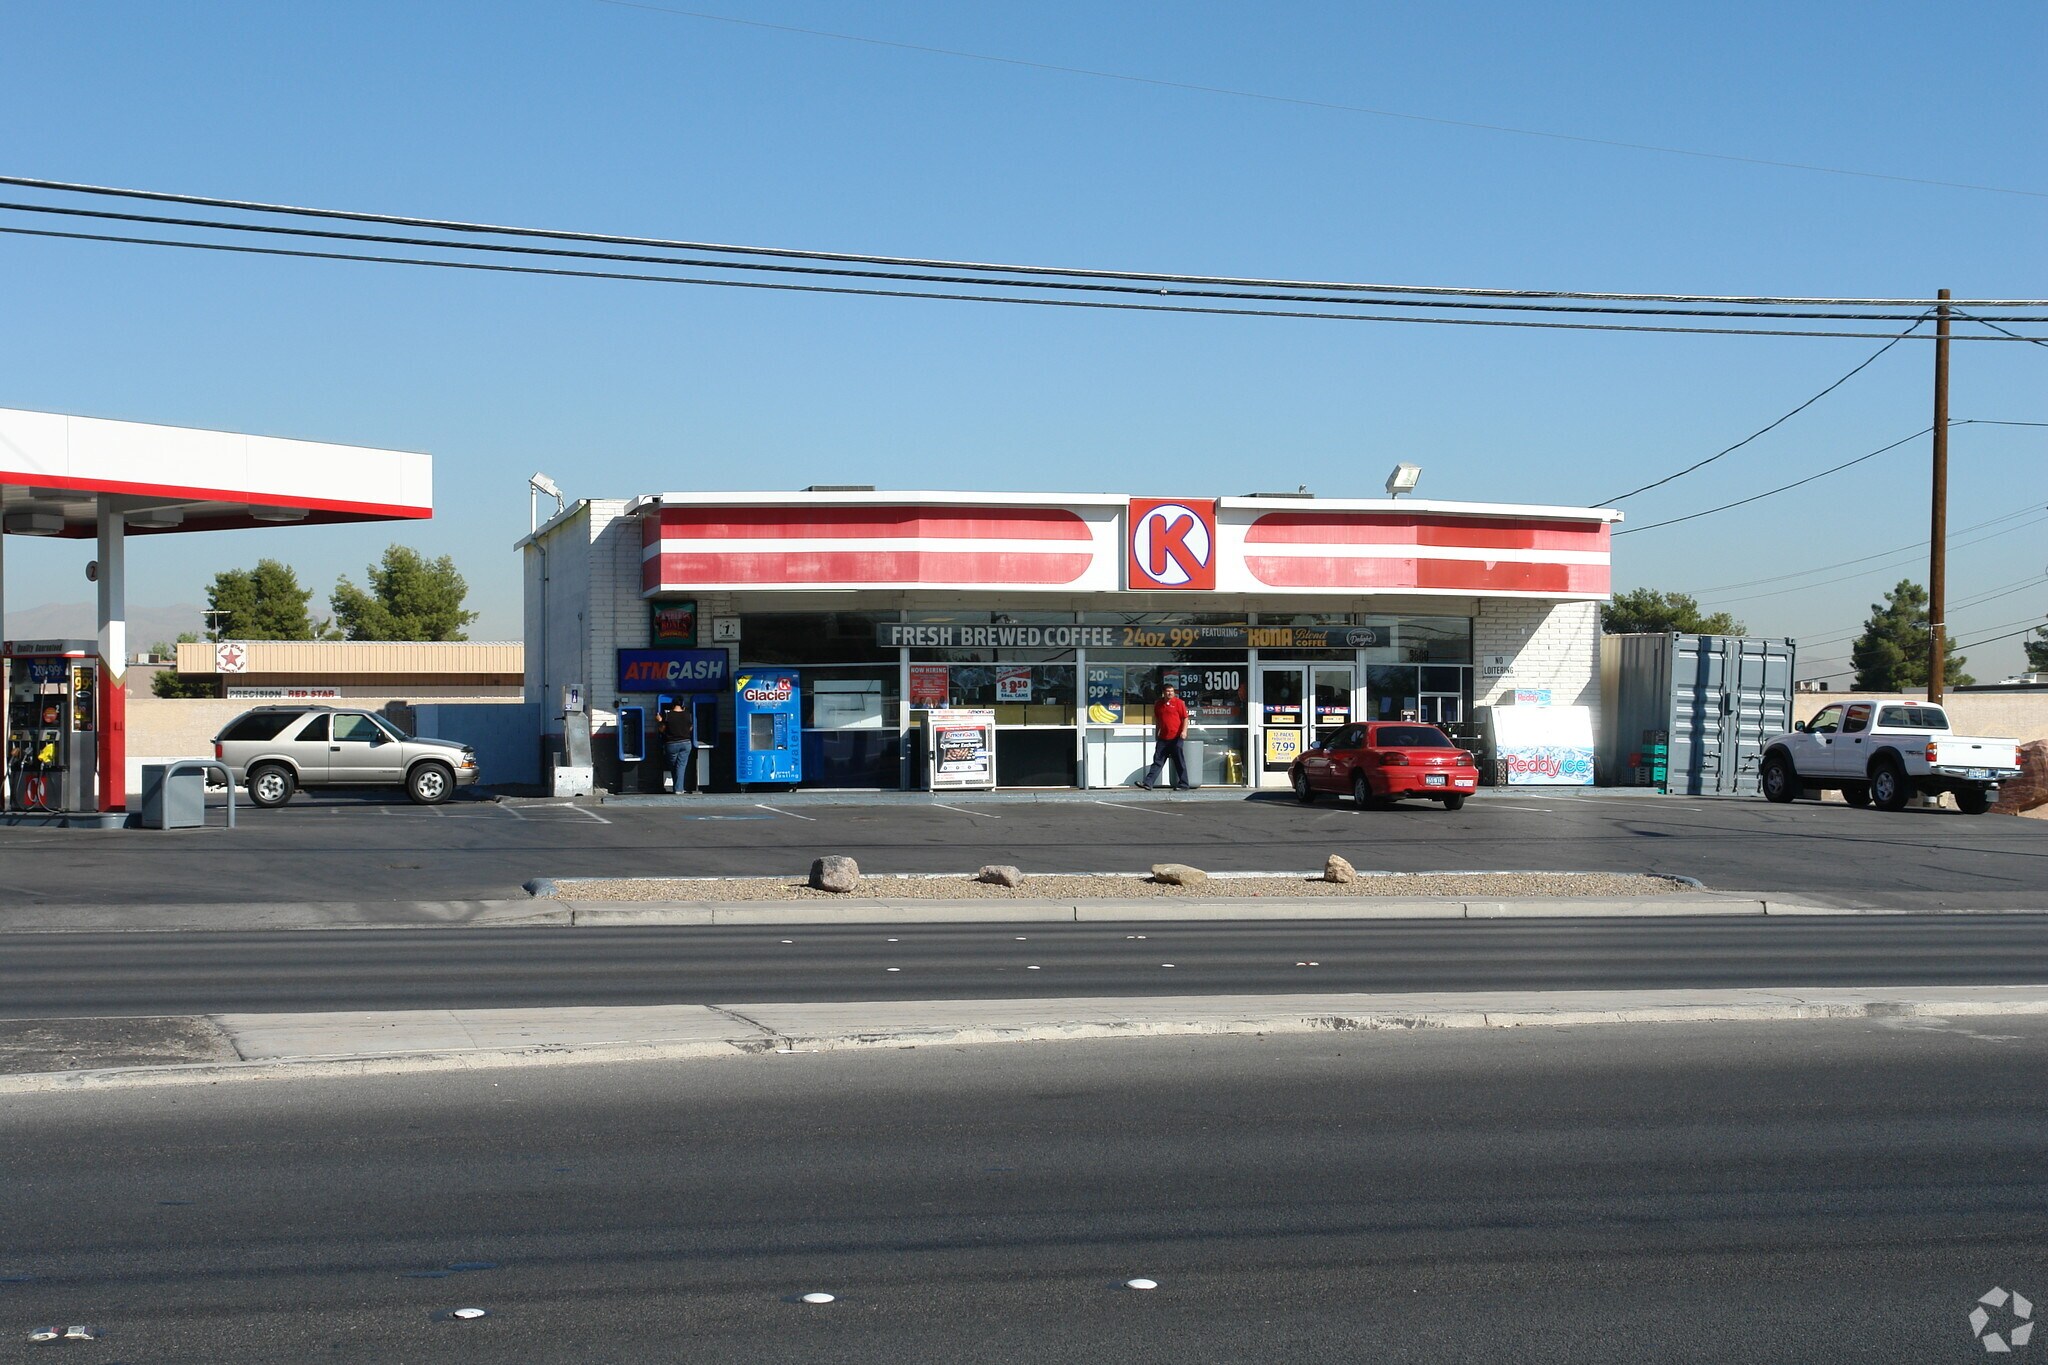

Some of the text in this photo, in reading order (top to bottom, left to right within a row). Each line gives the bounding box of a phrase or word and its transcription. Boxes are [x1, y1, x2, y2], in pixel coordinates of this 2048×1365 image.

[891, 626, 1293, 647] FRESH BREWED COFFEE 24oz 99¢ FEATURING KONA
[1294, 628, 1328, 640] Blend
[1295, 639, 1328, 647] COFFEE
[1494, 656, 1504, 664] NO
[1089, 670, 1108, 681] 20¢
[1483, 666, 1514, 675] LOITERING
[1204, 670, 1239, 690] 3500
[229, 689, 282, 698] PRECISION
[744, 689, 791, 701] Glacier
[1089, 685, 1108, 698] 99¢
[1517, 694, 1538, 703] Reddy
[945, 731, 976, 739] AmeriGas
[1271, 741, 1295, 752] $7.99
[1507, 754, 1586, 777] Reddy ice
